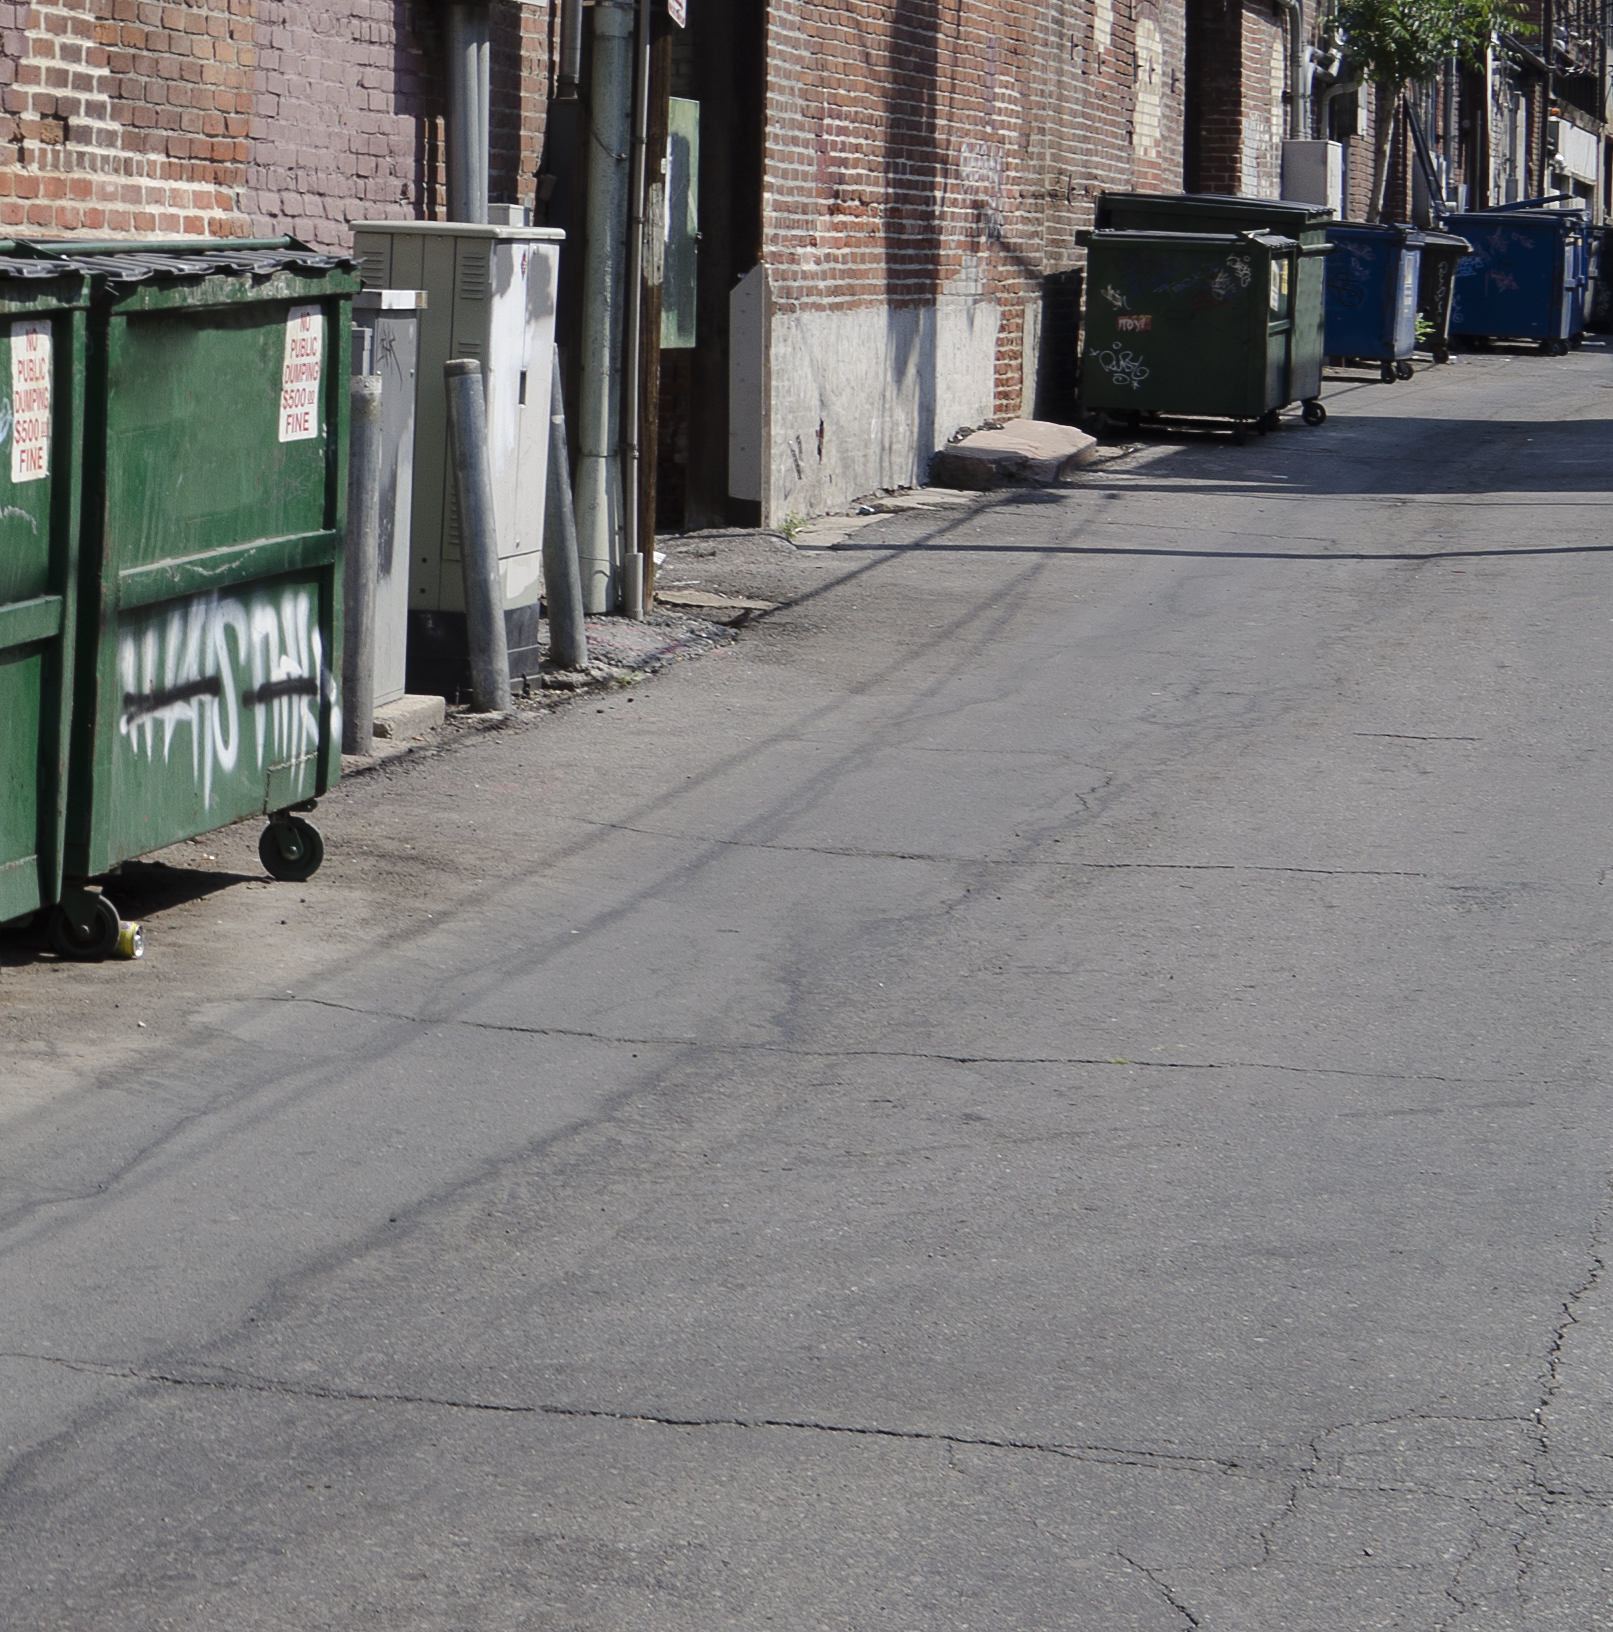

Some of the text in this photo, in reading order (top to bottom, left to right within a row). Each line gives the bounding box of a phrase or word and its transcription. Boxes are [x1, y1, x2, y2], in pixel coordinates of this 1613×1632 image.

[299, 311, 312, 333] NO
[25, 327, 39, 353] NO
[290, 336, 318, 359] PUBLIC
[17, 356, 47, 383] PUBLIC
[284, 361, 320, 385] DUMPING
[14, 386, 49, 414] DUMPING
[285, 411, 311, 435] FINE
[19, 446, 44, 474] FINE
